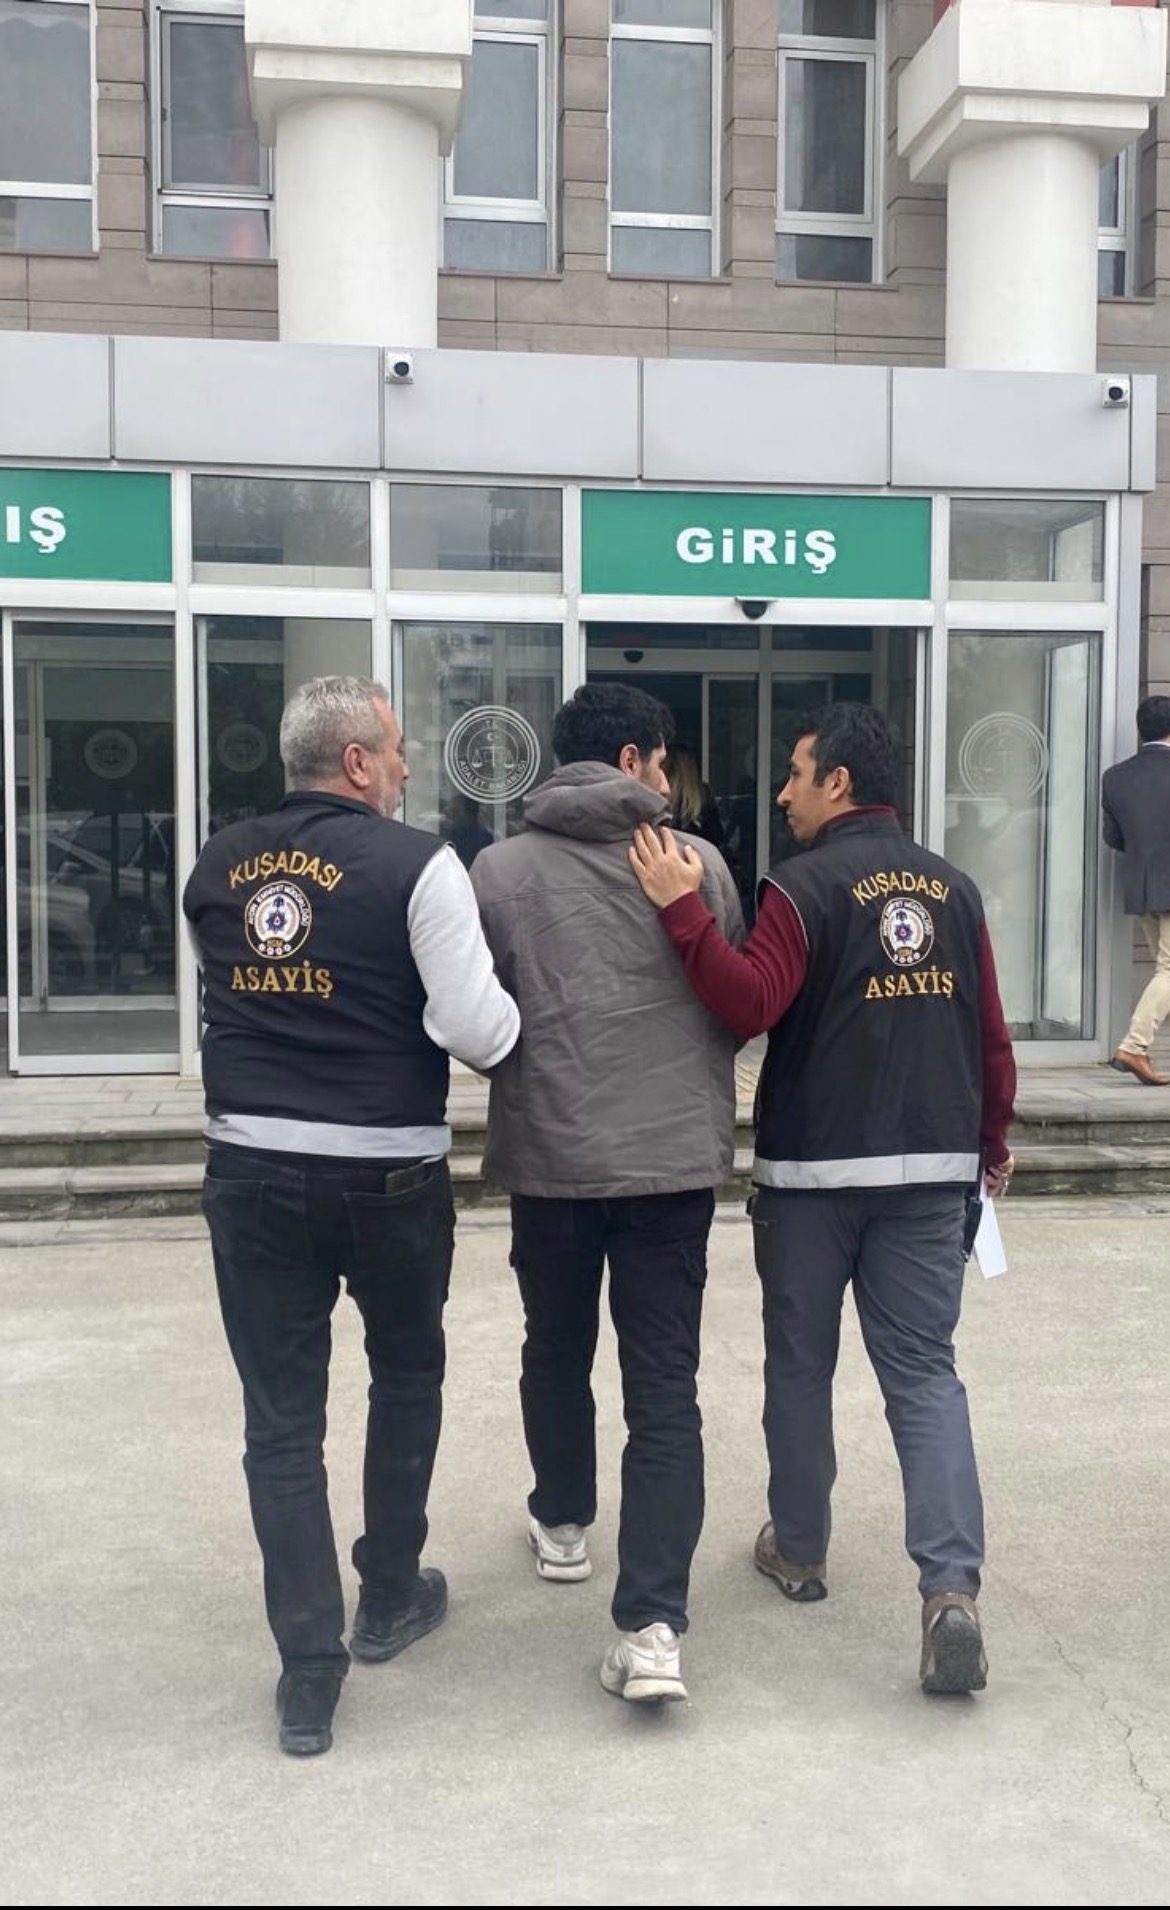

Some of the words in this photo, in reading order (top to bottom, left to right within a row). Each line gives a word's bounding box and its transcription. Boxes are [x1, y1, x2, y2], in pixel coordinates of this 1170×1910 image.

[229, 850, 344, 891] KUŞADASI
[852, 871, 949, 906] KUŞADASI
[231, 960, 333, 998] ASAYİŞ
[865, 965, 953, 998] ASAYİŞ
